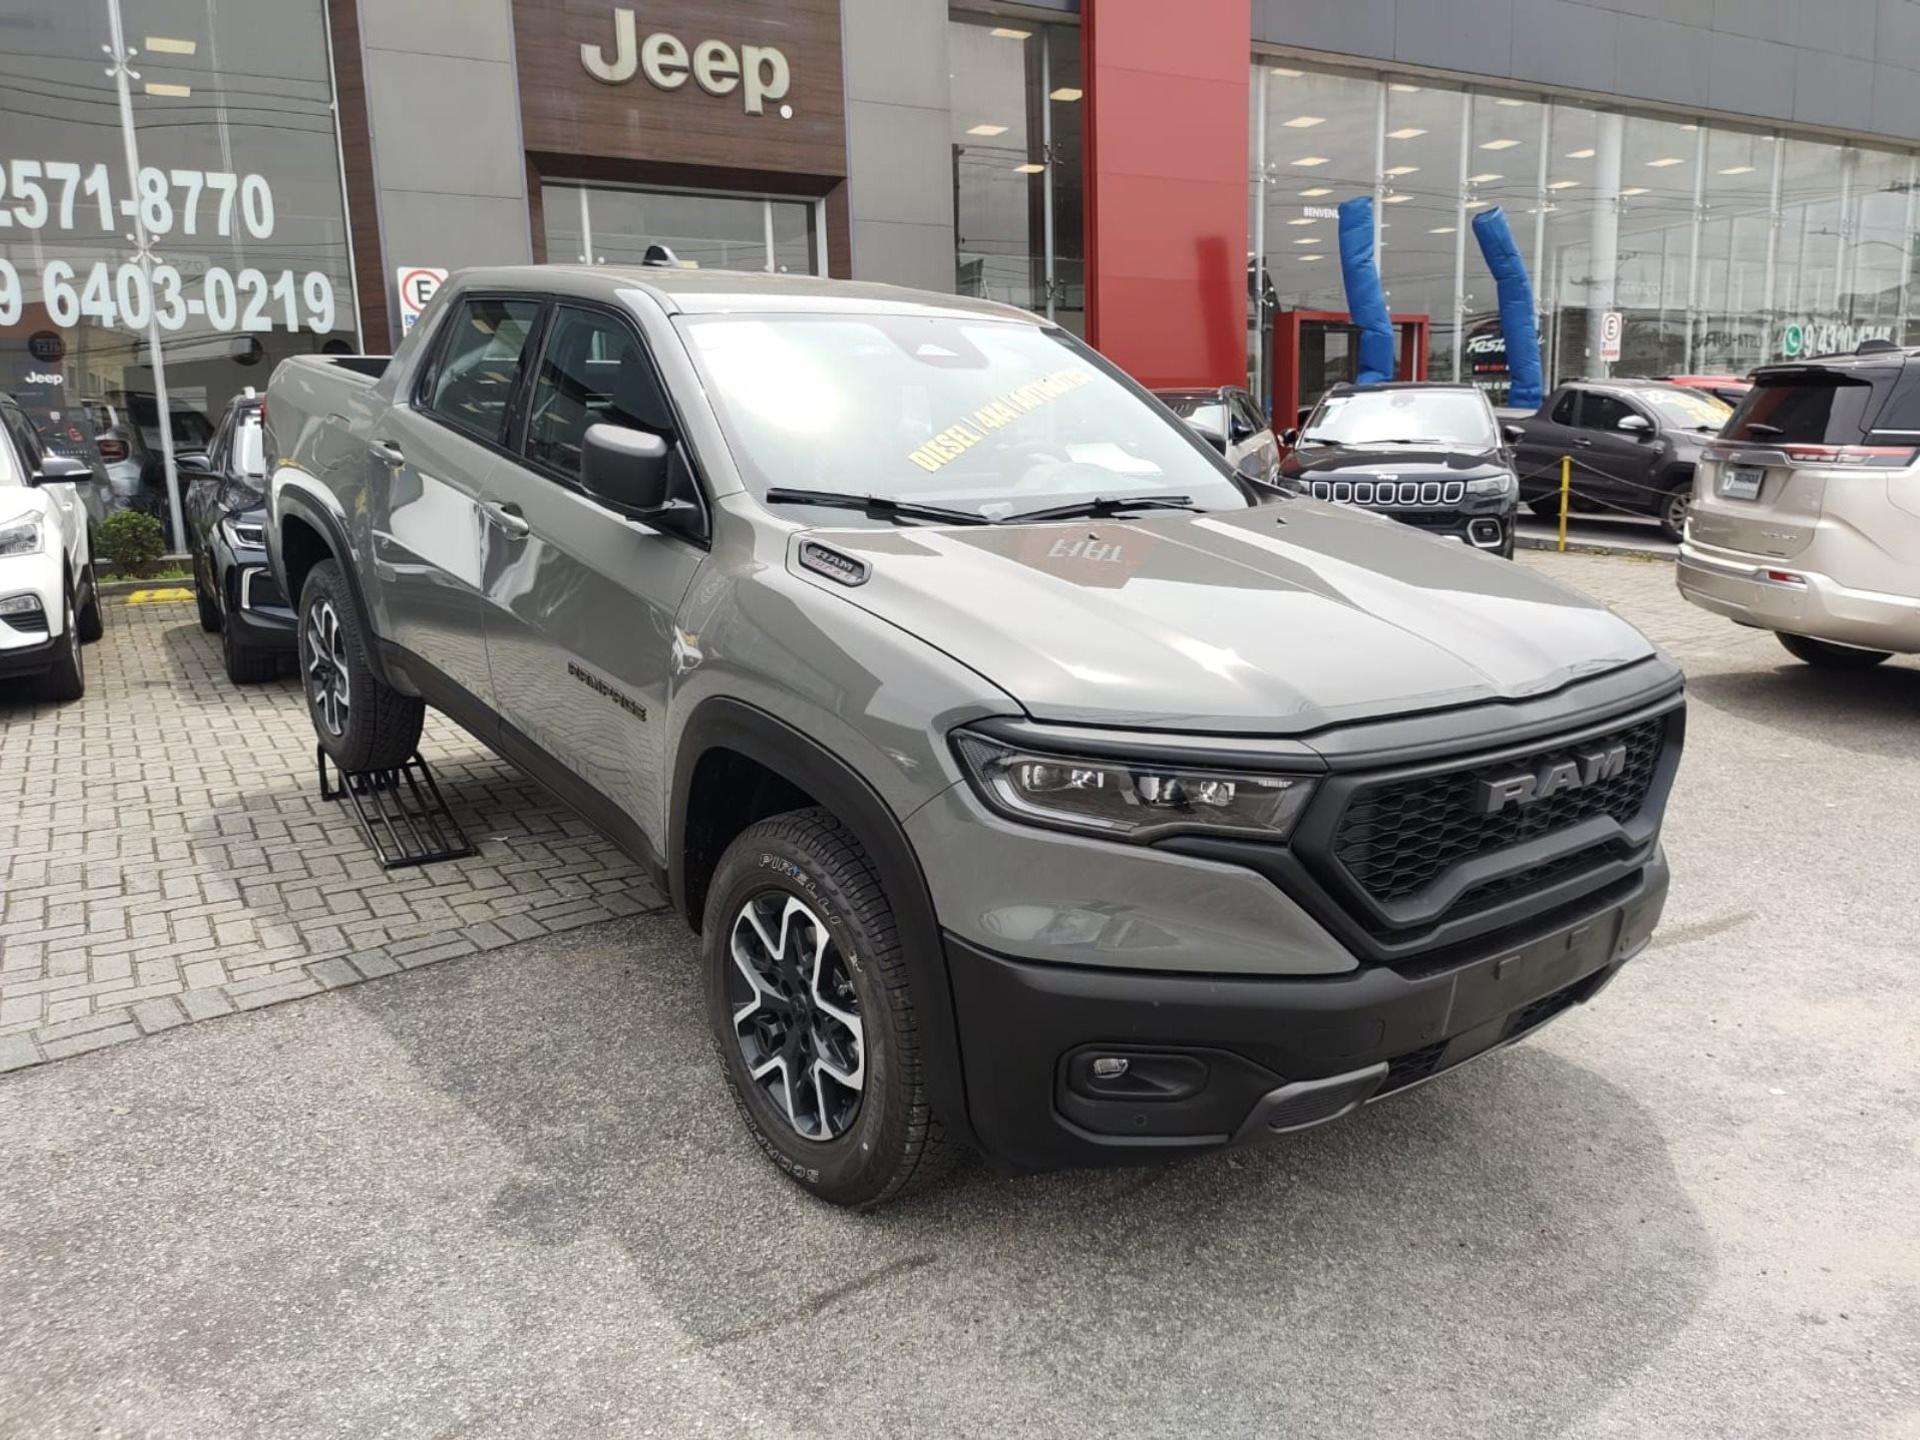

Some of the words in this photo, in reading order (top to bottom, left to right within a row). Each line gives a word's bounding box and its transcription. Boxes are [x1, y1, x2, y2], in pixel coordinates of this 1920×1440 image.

[580, 7, 790, 116] Jeep
[0, 258, 22, 326] 9
[43, 260, 335, 334] 6403-0219
[416, 279, 431, 304] E
[25, 371, 63, 386] Jeep
[908, 424, 982, 472] DIESEL
[815, 550, 857, 574] RAM
[1485, 745, 1627, 813] RAM
[759, 853, 841, 925] PIRELLI
